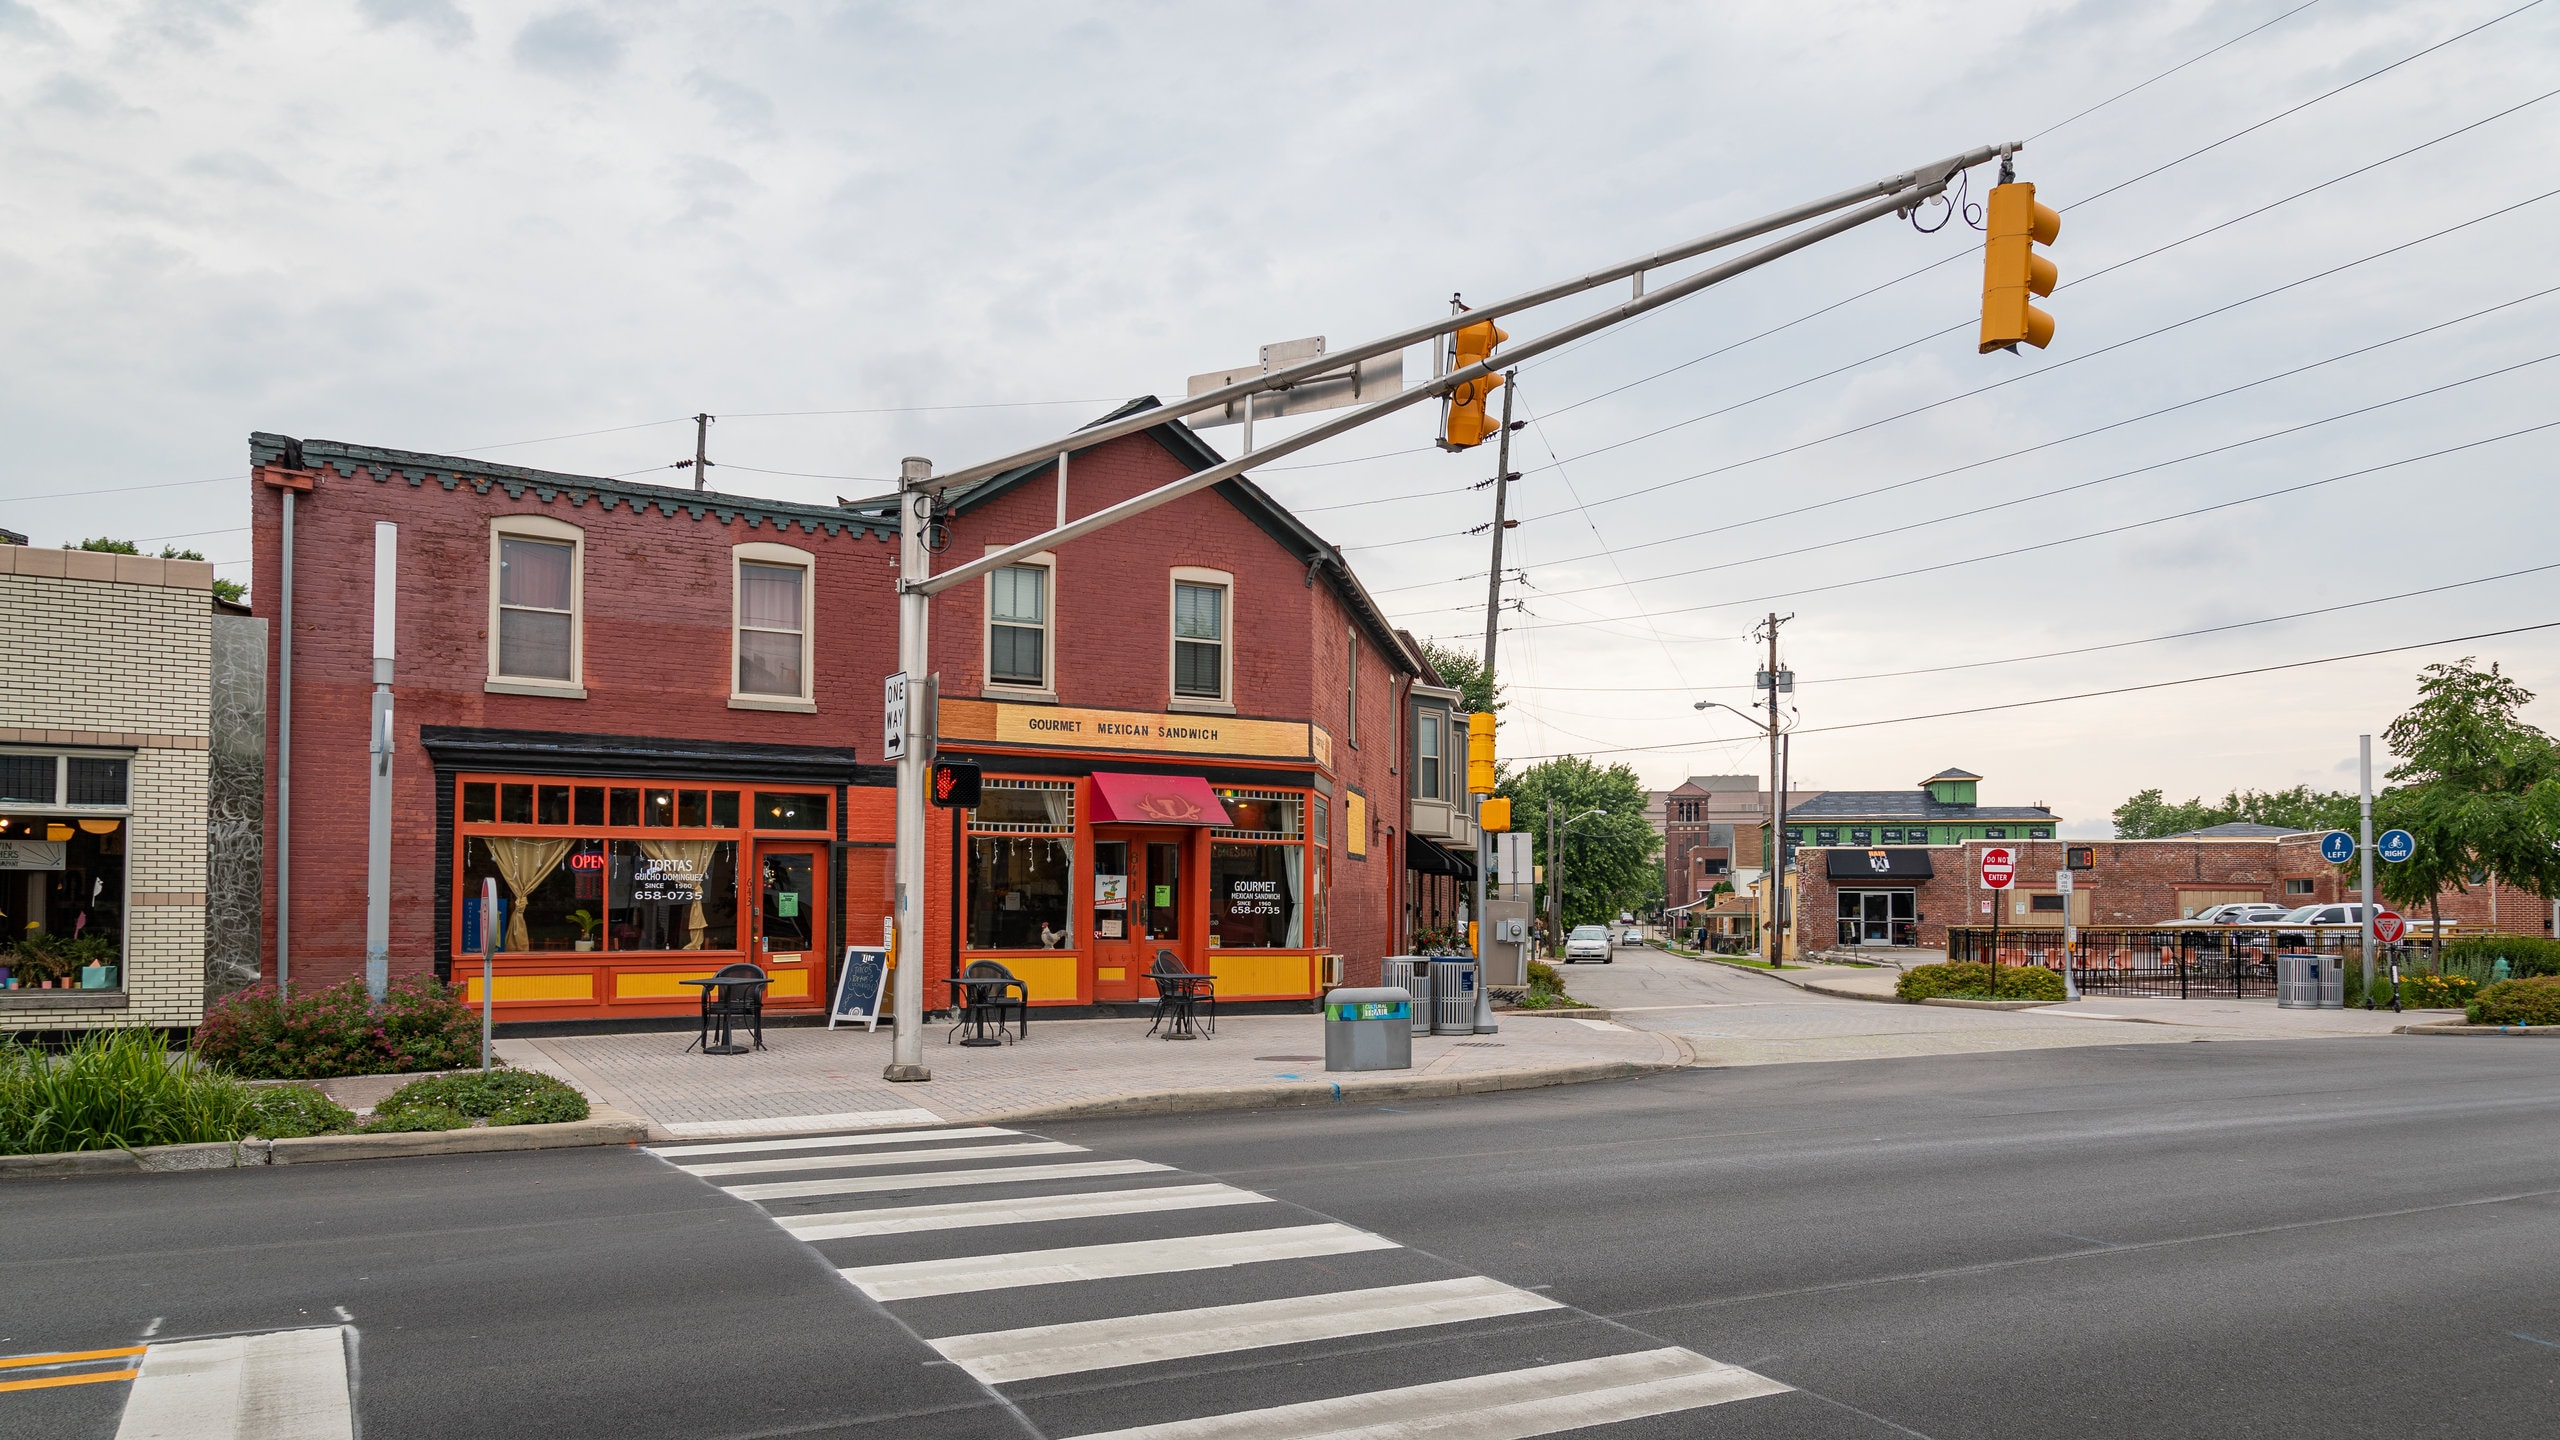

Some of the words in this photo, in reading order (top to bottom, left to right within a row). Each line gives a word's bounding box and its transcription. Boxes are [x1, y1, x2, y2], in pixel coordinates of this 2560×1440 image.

[888, 682, 904, 703] ONE
[887, 708, 904, 729] WAY
[1029, 718, 1082, 732] GOURMET
[1098, 723, 1149, 736] MEXICAN
[1158, 726, 1218, 741] SANDWICH
[648, 859, 693, 872] TORTAS
[634, 873, 661, 881] GUICHO
[662, 873, 703, 882] DOMINGUEZ
[1234, 881, 1276, 892] GOURMET
[634, 891, 703, 900] 658-0735
[1231, 906, 1281, 915] 658-0735
